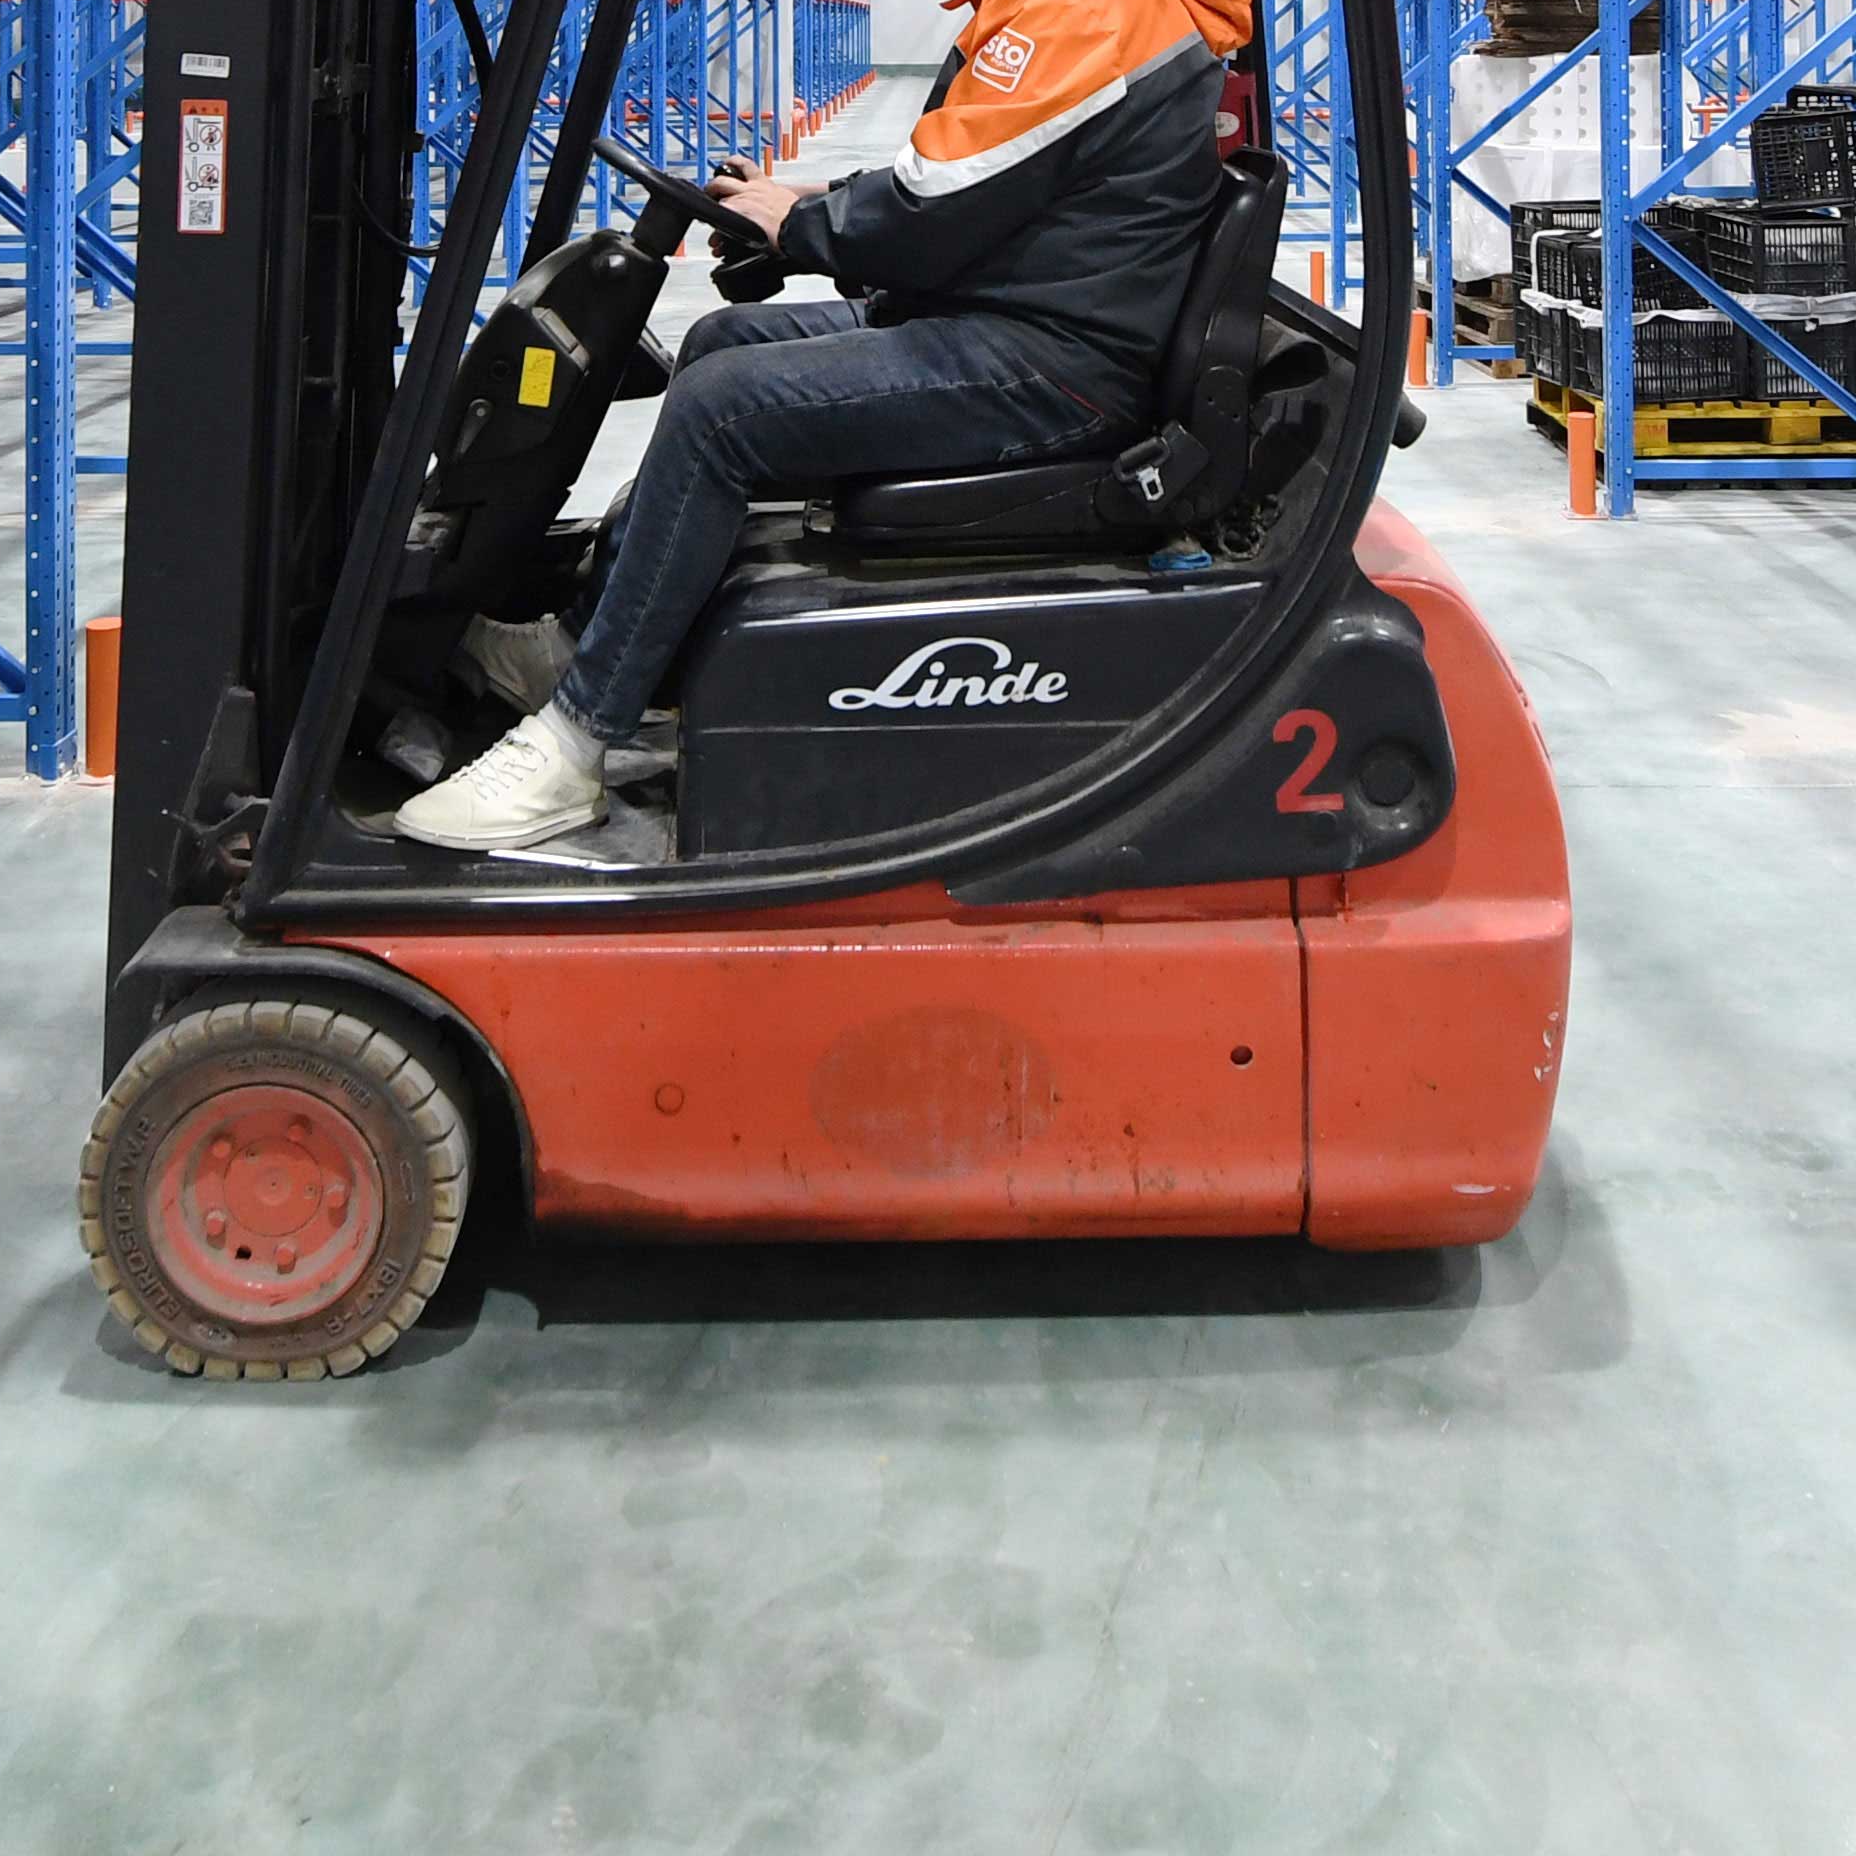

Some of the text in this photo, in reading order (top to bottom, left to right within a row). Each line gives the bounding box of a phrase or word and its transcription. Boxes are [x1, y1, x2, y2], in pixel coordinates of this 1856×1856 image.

[983, 34, 1025, 66] sto
[828, 637, 1069, 710] Linde
[1272, 708, 1344, 814] 2
